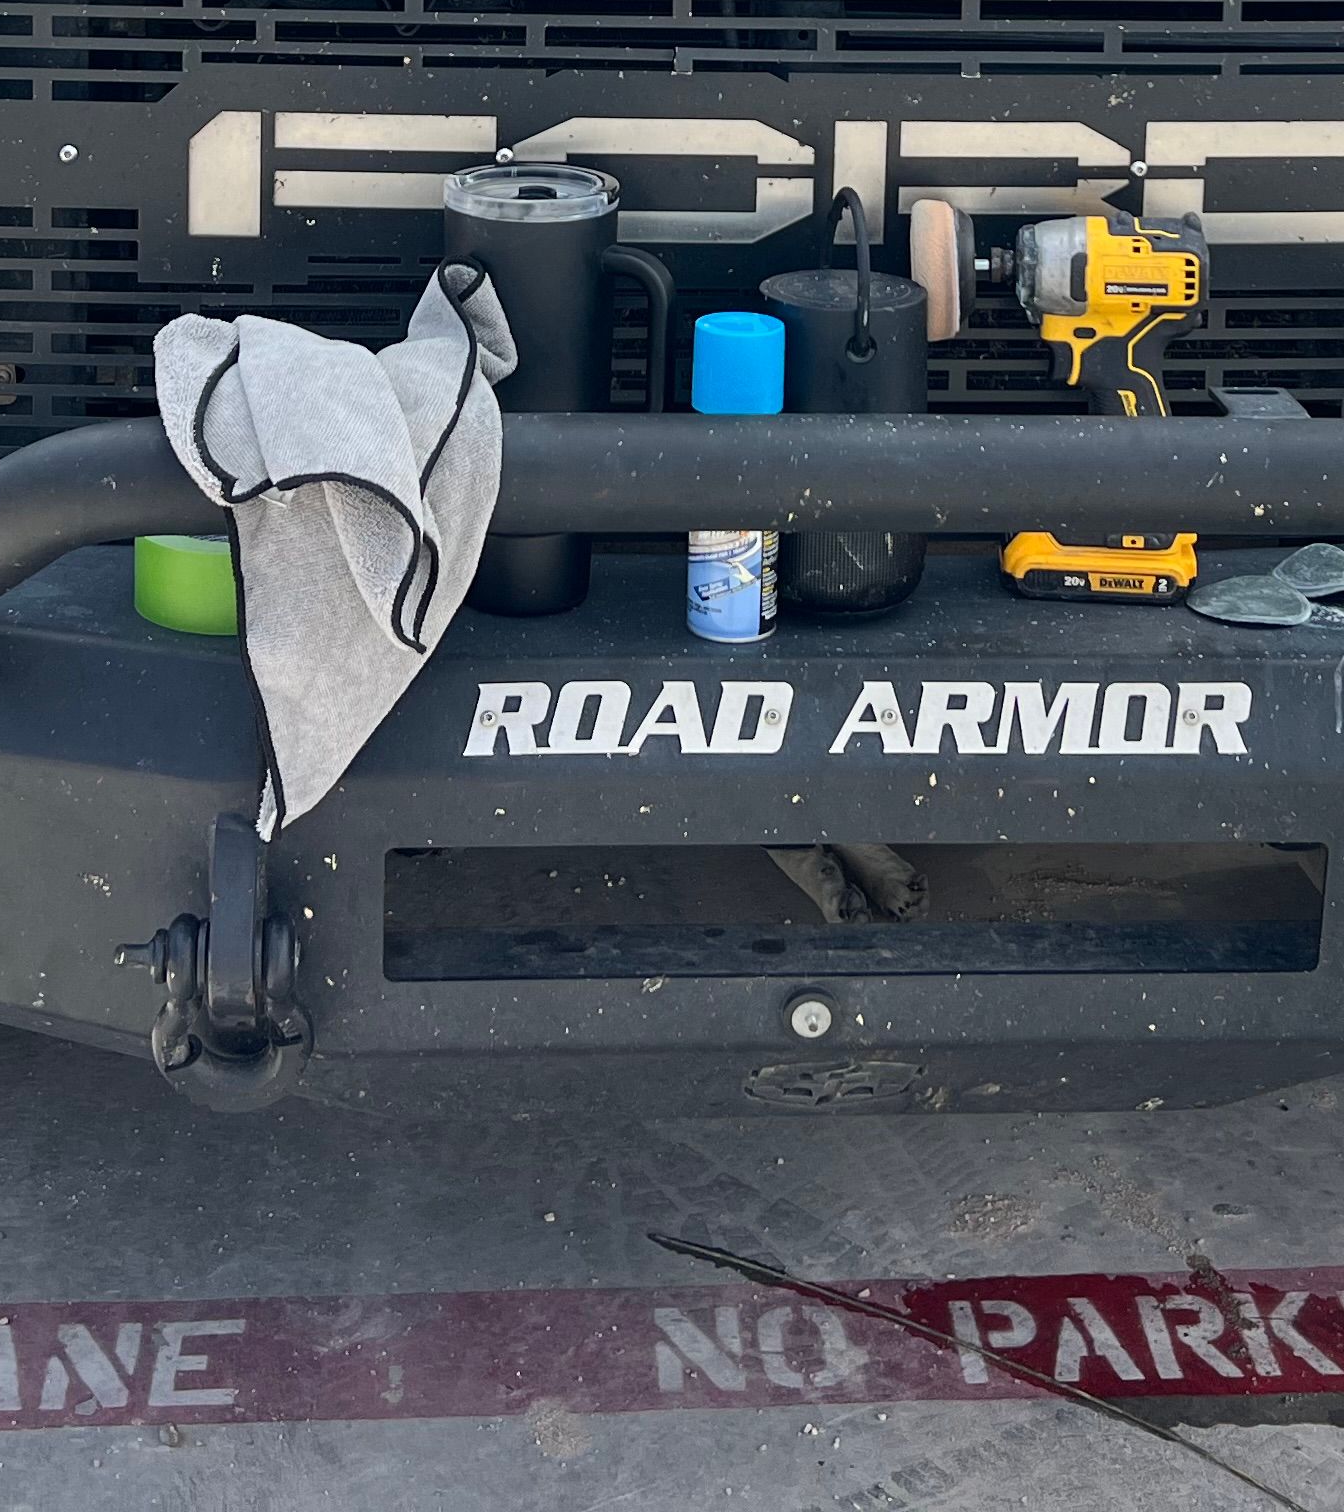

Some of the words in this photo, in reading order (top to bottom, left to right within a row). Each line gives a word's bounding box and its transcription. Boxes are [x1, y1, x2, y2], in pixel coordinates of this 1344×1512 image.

[462, 681, 795, 756] ROAD
[828, 681, 1253, 755] ARMOR
[656, 1303, 859, 1392] NO
